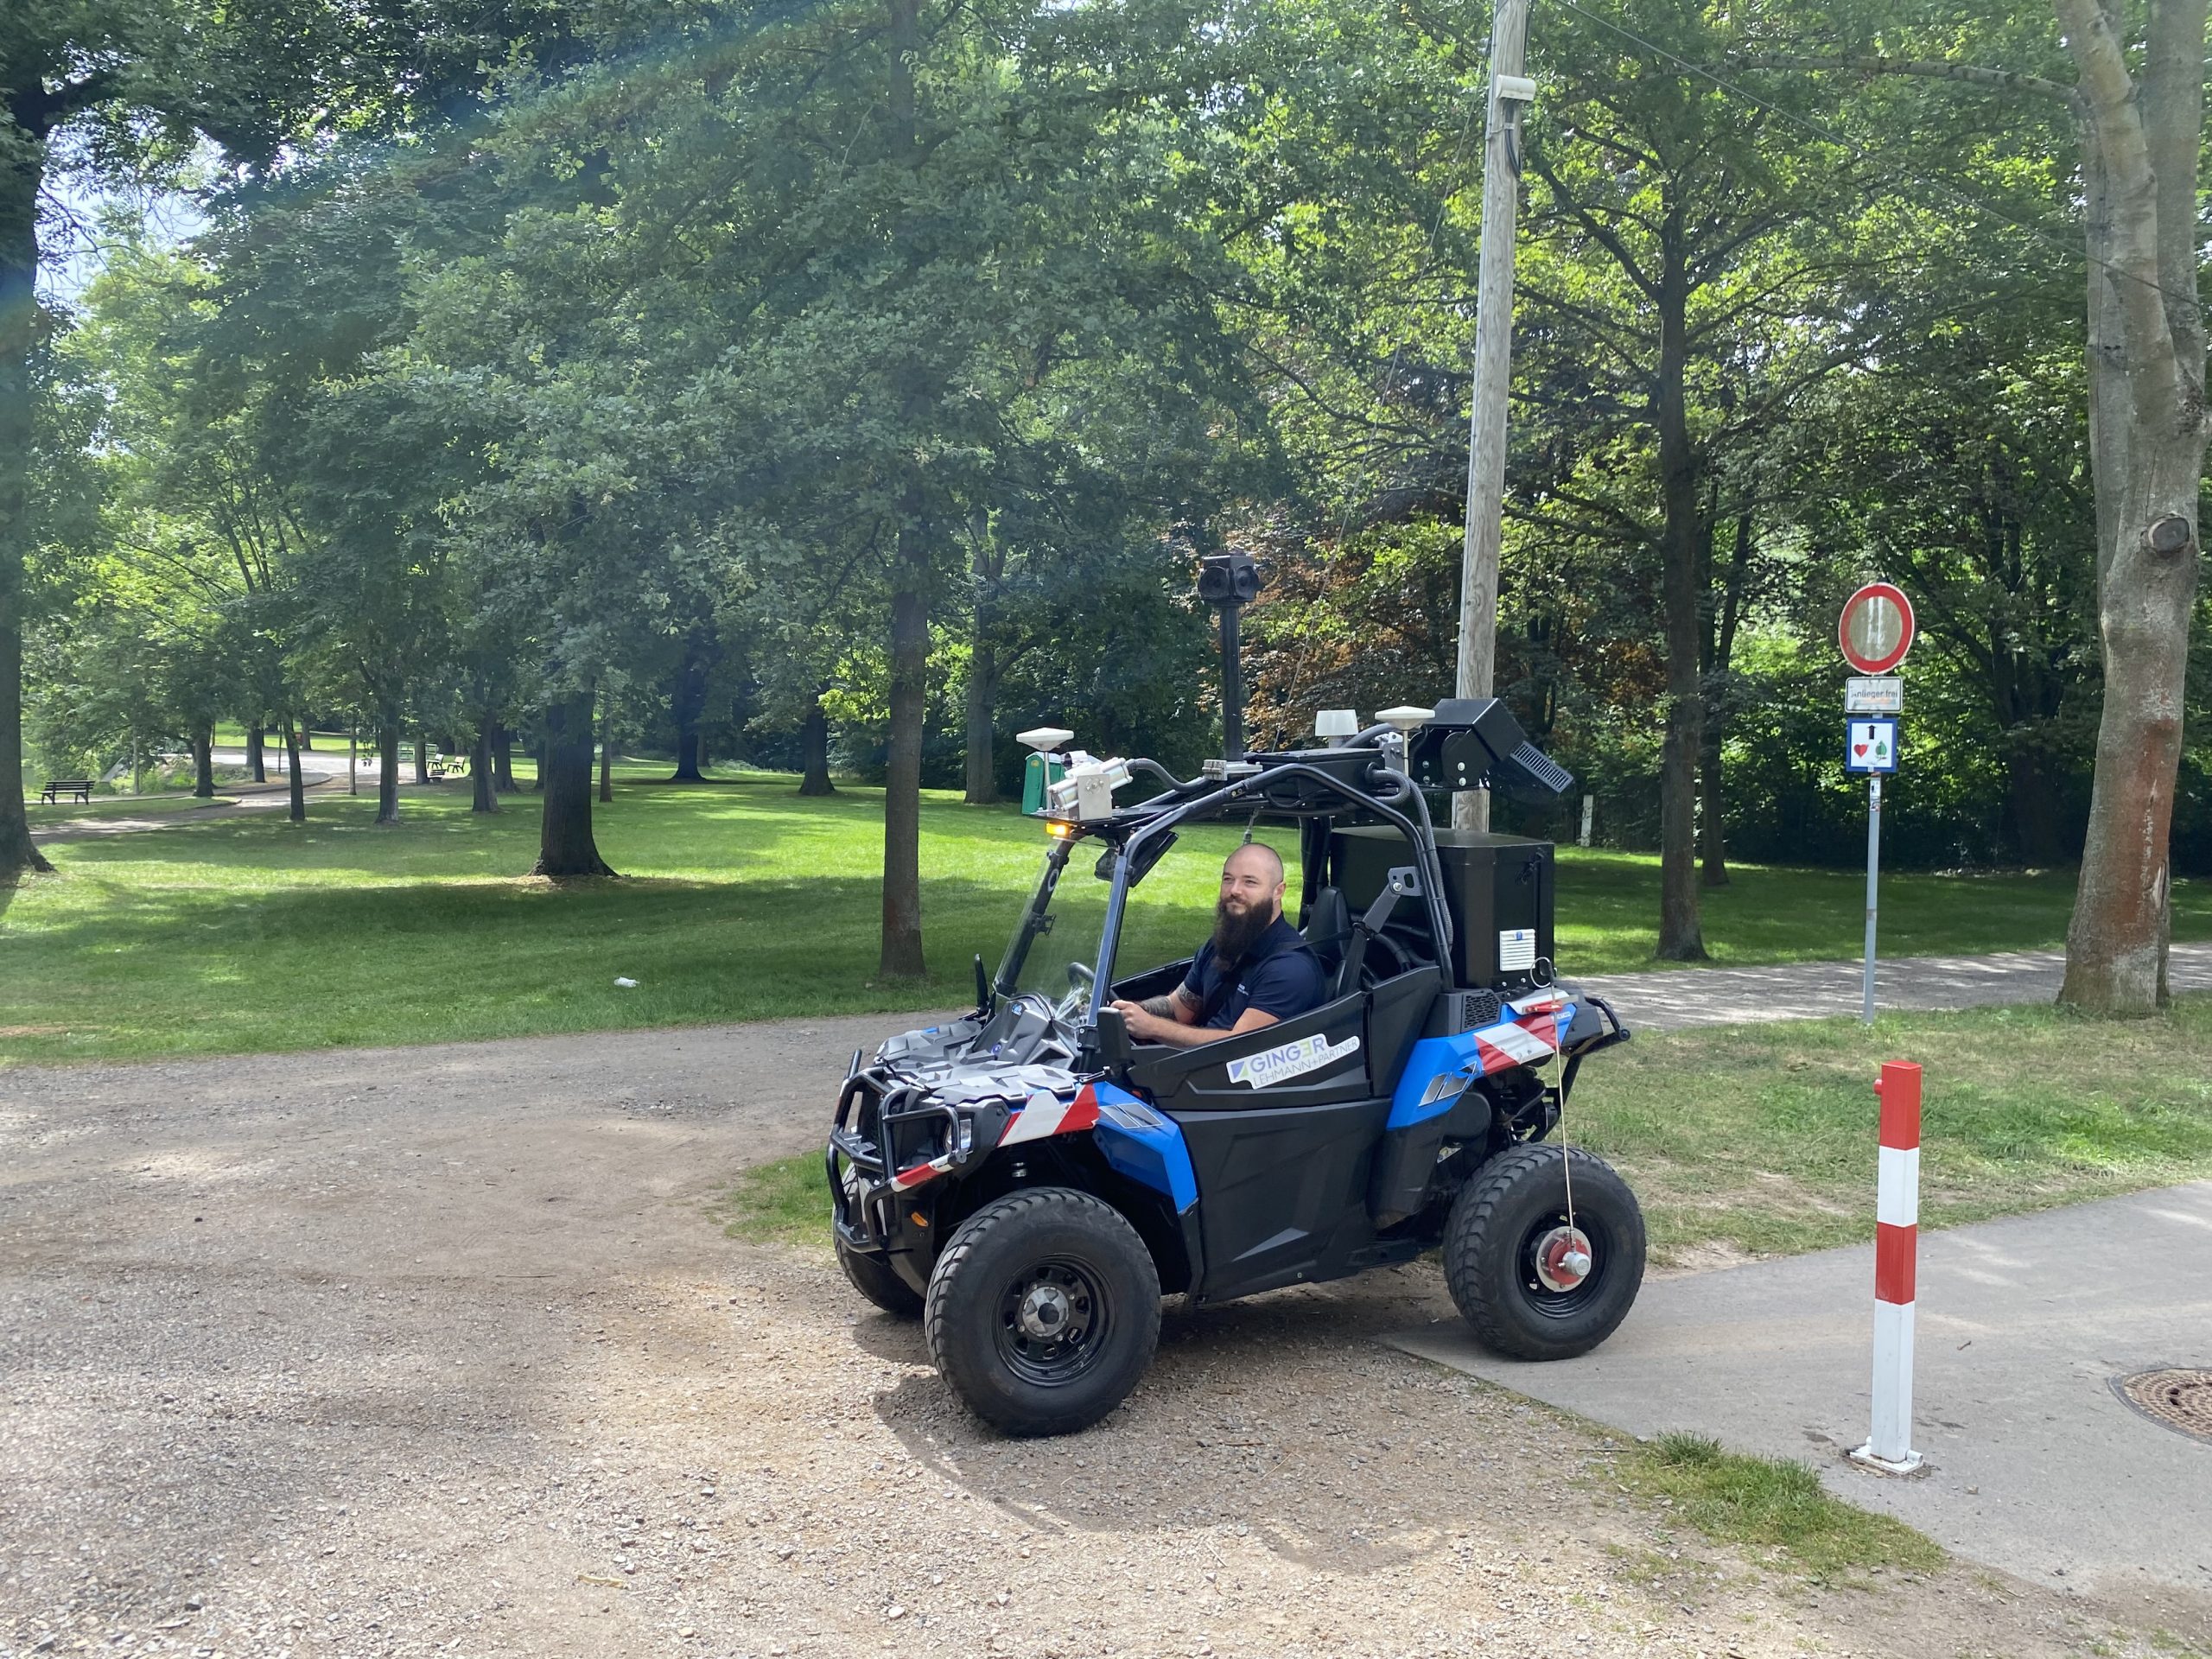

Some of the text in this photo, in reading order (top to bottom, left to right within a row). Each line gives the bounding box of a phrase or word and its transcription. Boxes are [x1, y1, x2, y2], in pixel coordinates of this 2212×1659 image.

[1885, 689, 1898, 698] frei
[1249, 1037, 1325, 1073] GINGER
[1253, 1039, 1358, 1087] LEHMANN+PARTNER
